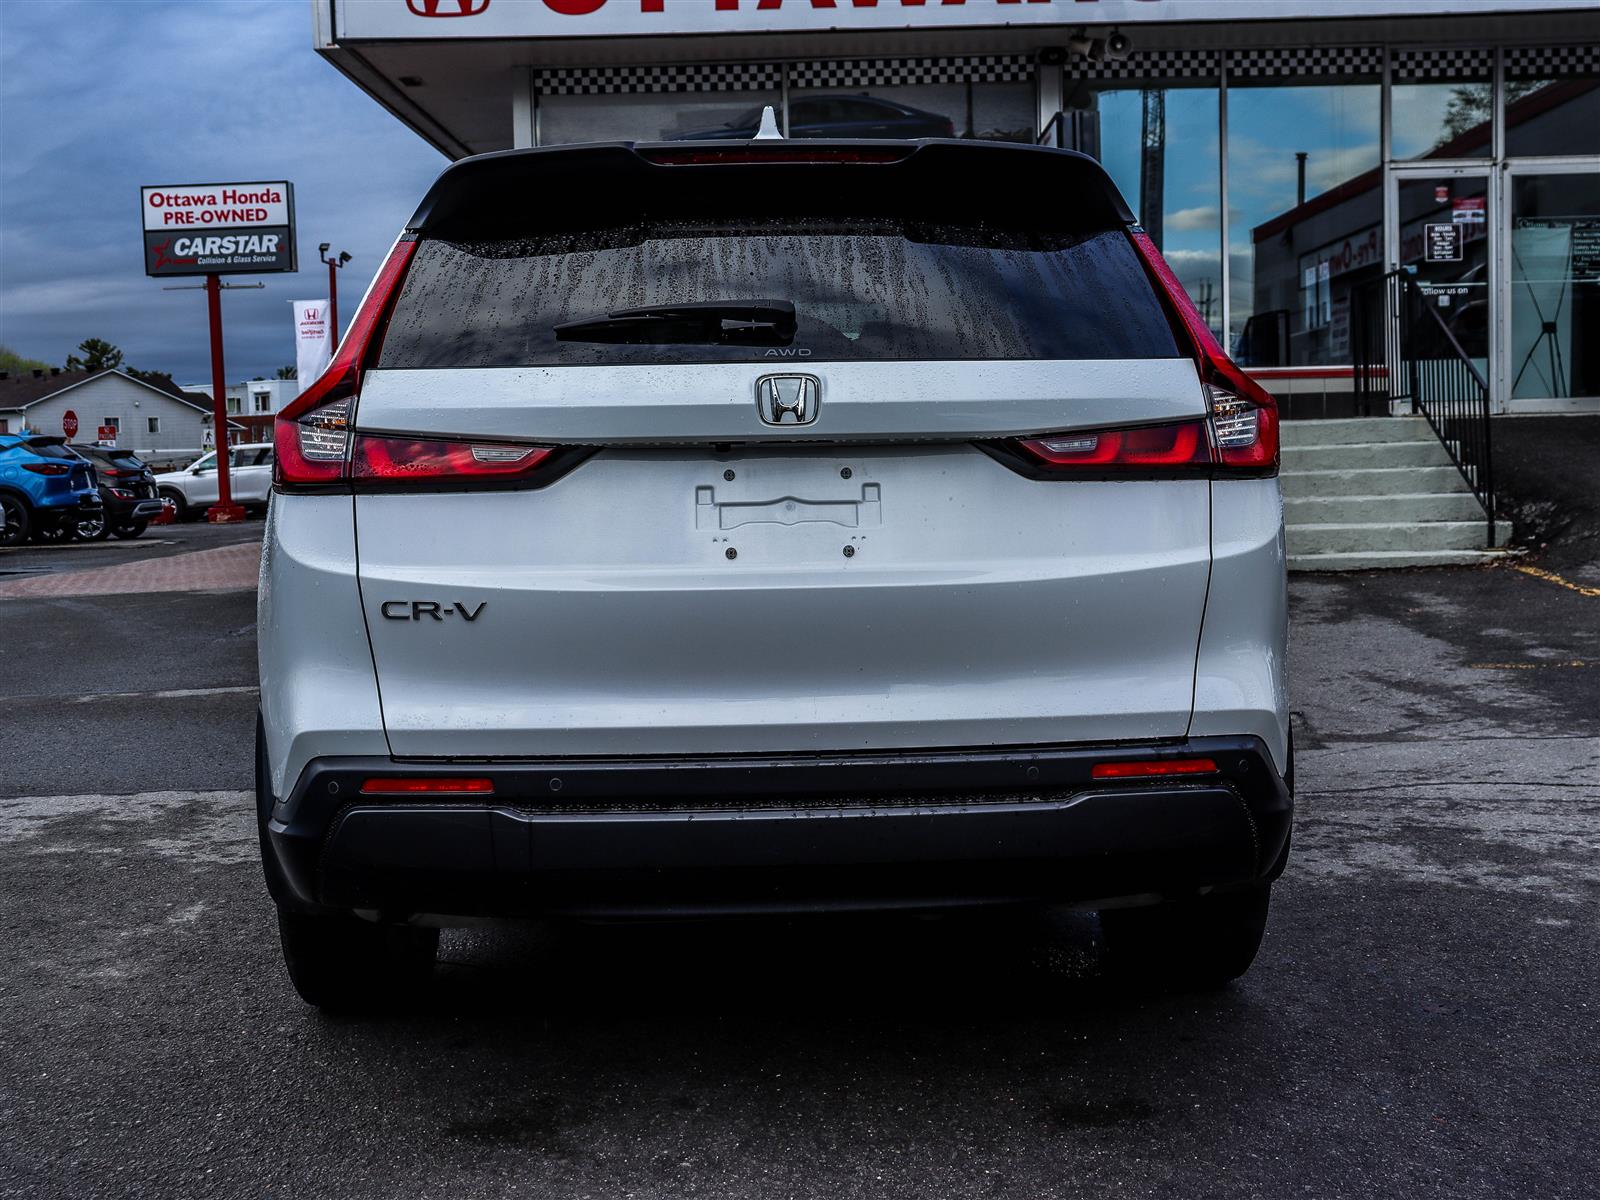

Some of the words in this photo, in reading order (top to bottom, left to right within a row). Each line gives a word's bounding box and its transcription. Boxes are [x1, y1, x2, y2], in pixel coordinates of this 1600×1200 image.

[149, 191, 217, 208] Ottawa
[222, 188, 281, 205] Honda
[163, 208, 268, 225] PRE-OWNED
[173, 234, 279, 256] CARSTAR
[197, 256, 226, 265] Collision
[226, 256, 232, 264] &
[233, 255, 252, 264] Glass
[252, 254, 277, 263] Service
[764, 348, 812, 357] AWD
[64, 418, 78, 430] STOP
[380, 600, 488, 621] CR-V
